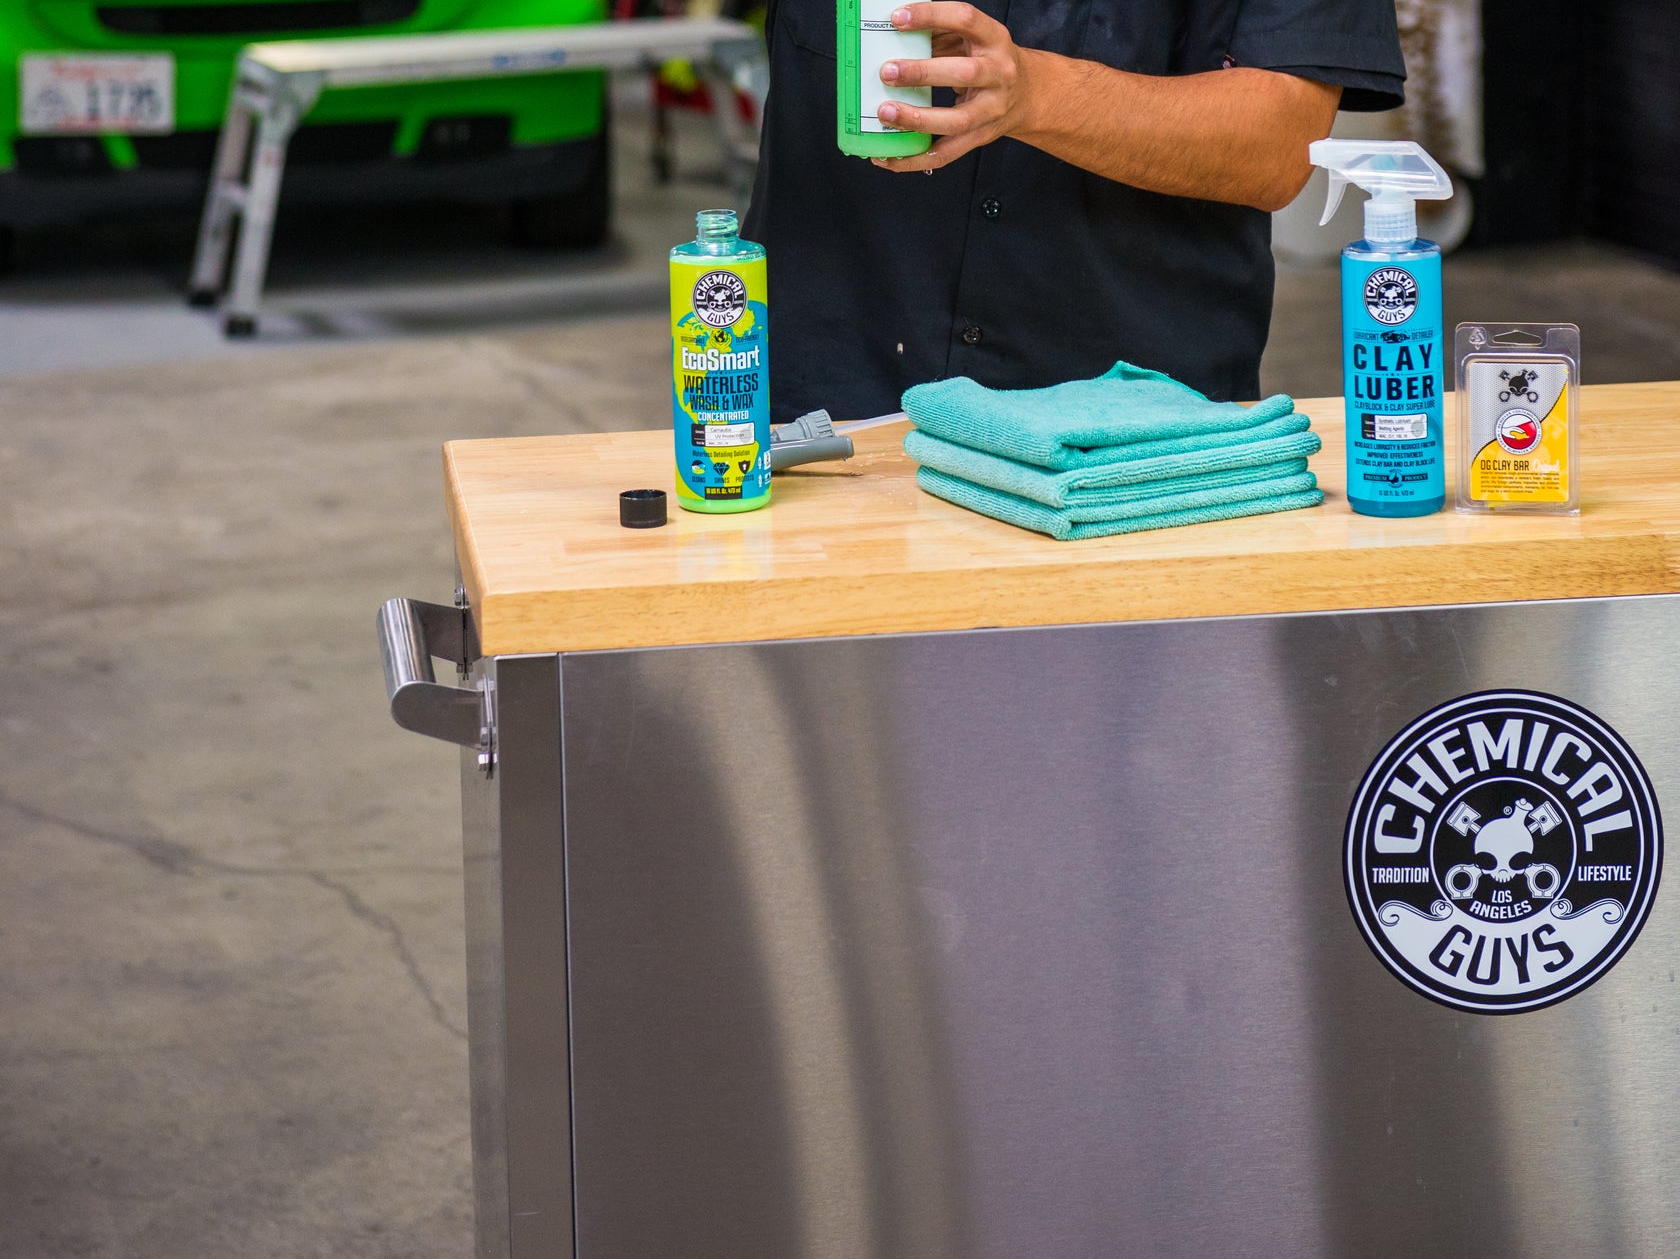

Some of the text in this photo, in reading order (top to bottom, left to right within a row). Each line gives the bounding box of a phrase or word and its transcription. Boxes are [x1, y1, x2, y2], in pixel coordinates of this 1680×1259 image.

[696, 274, 745, 301] CHEMICAL
[1365, 270, 1418, 298] CHEMICAL
[706, 310, 735, 324] GUYS
[1377, 309, 1406, 322] GUYS
[681, 345, 760, 372] EcoSmart
[1353, 342, 1433, 372] CLAY
[684, 373, 759, 394] WATERLESS
[1354, 374, 1435, 400] LUBER
[690, 393, 754, 411] WASH & WAX
[1390, 404, 1404, 412] CLAY
[1406, 402, 1423, 411] SUPER
[698, 410, 750, 422] CONCENTRATED
[1480, 460, 1491, 470] OG
[1493, 460, 1512, 470] CLAY
[1514, 460, 1530, 471] BAR
[1374, 718, 1634, 854] CHEMICAL
[1372, 867, 1430, 884] TRADITION
[1578, 866, 1632, 882] LIFESTYLE
[1492, 890, 1512, 903] LOS
[1470, 900, 1532, 920] ANGELES
[1428, 923, 1574, 986] GUYS
